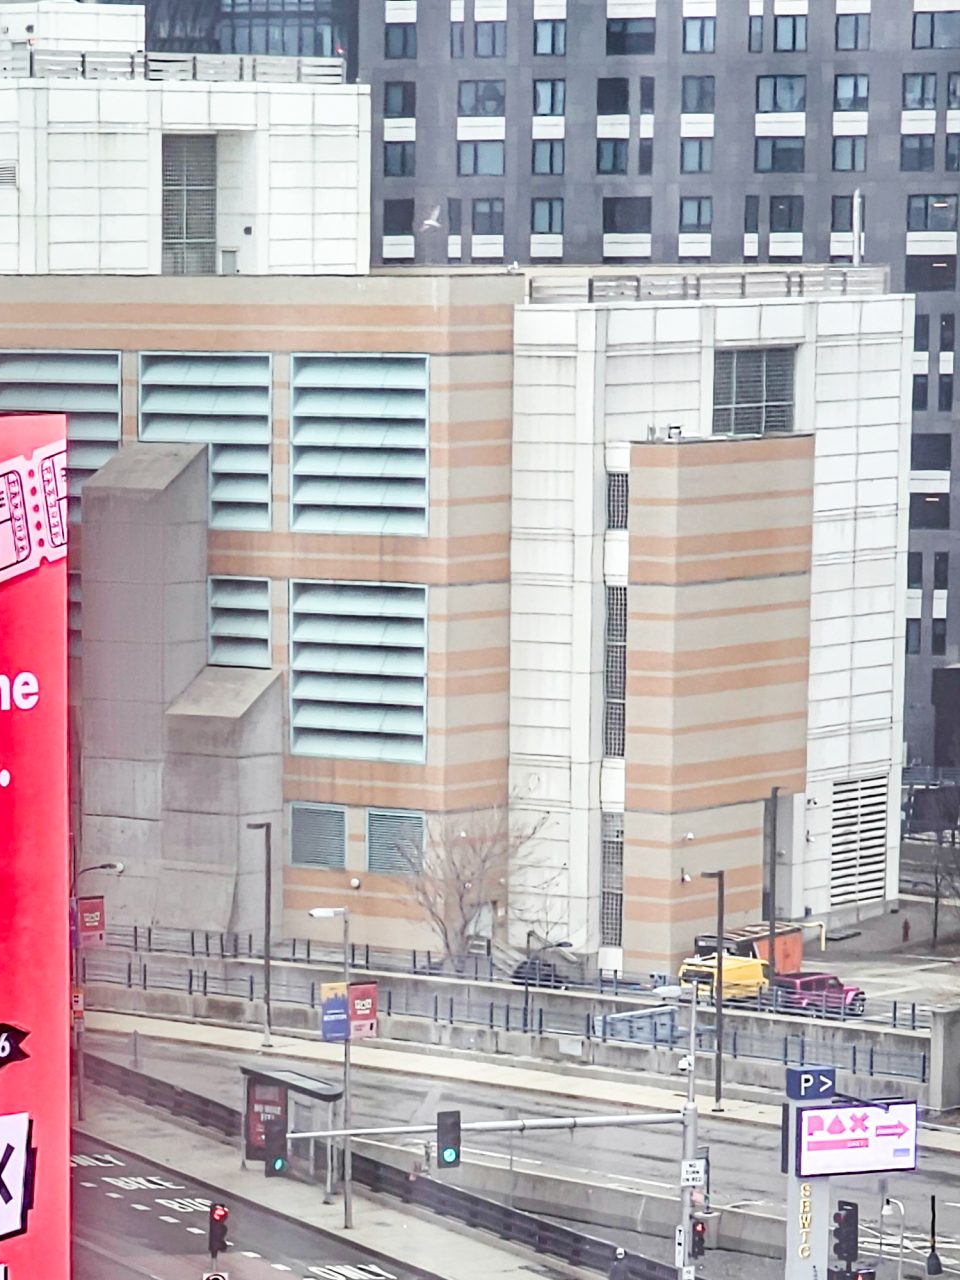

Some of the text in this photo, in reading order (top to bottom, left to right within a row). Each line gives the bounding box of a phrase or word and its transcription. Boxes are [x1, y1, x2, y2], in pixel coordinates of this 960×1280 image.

[800, 1074, 814, 1096] P
[71, 1154, 126, 1166] NLY
[101, 1176, 185, 1190] BIKE
[308, 1264, 397, 1280] ONLY
